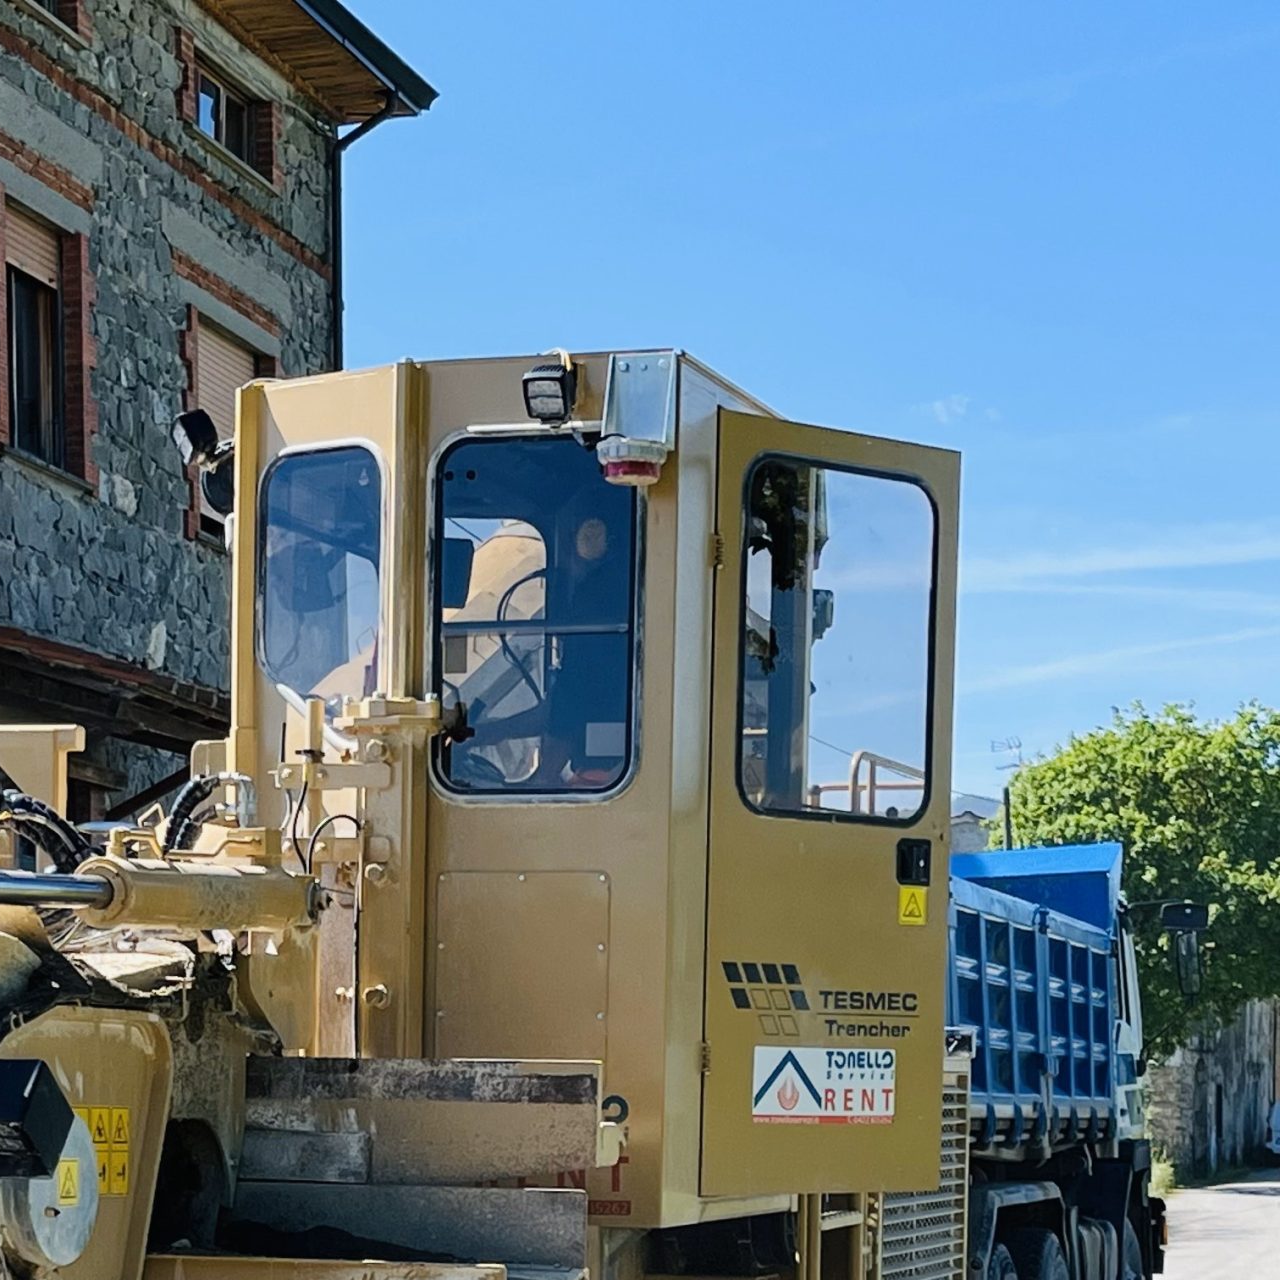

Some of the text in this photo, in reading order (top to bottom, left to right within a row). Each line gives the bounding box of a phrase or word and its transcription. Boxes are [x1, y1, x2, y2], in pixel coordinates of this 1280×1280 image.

[819, 990, 918, 1012] TESMEC
[824, 1019, 911, 1037] Trencher
[825, 1050, 894, 1069] TONELLO
[824, 1088, 893, 1112] RENT
